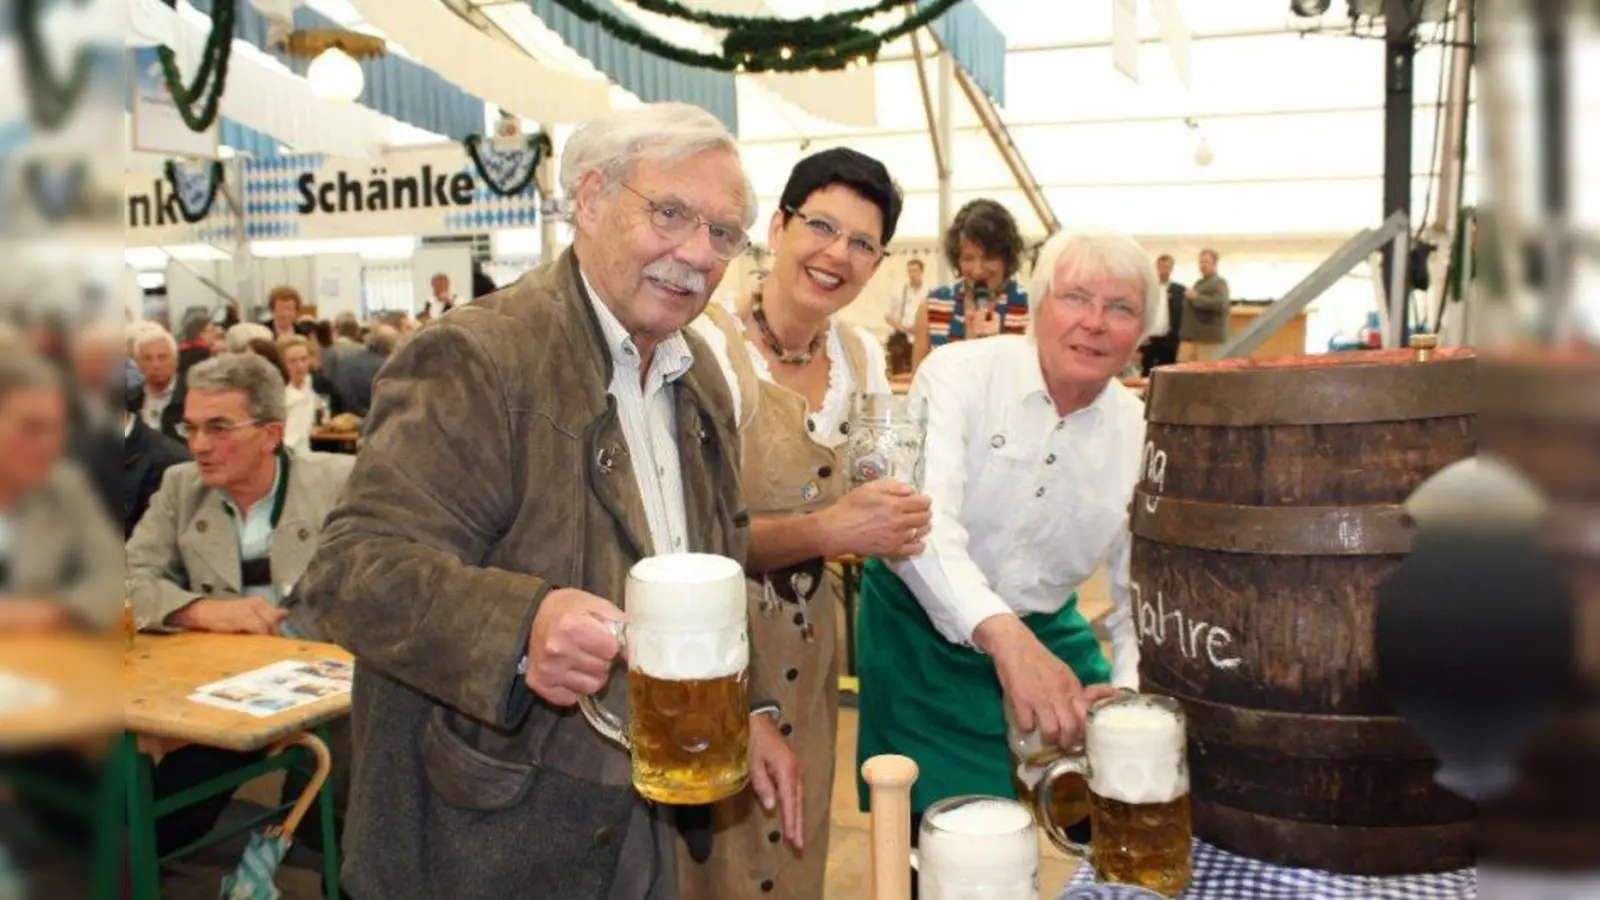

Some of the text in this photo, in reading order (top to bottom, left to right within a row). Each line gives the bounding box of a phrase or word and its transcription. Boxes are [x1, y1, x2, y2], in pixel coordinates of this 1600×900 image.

[129, 178, 179, 227] nk
[298, 164, 475, 215] Schänke
[1140, 440, 1168, 514] ng
[1129, 581, 1242, 669] Jahre
